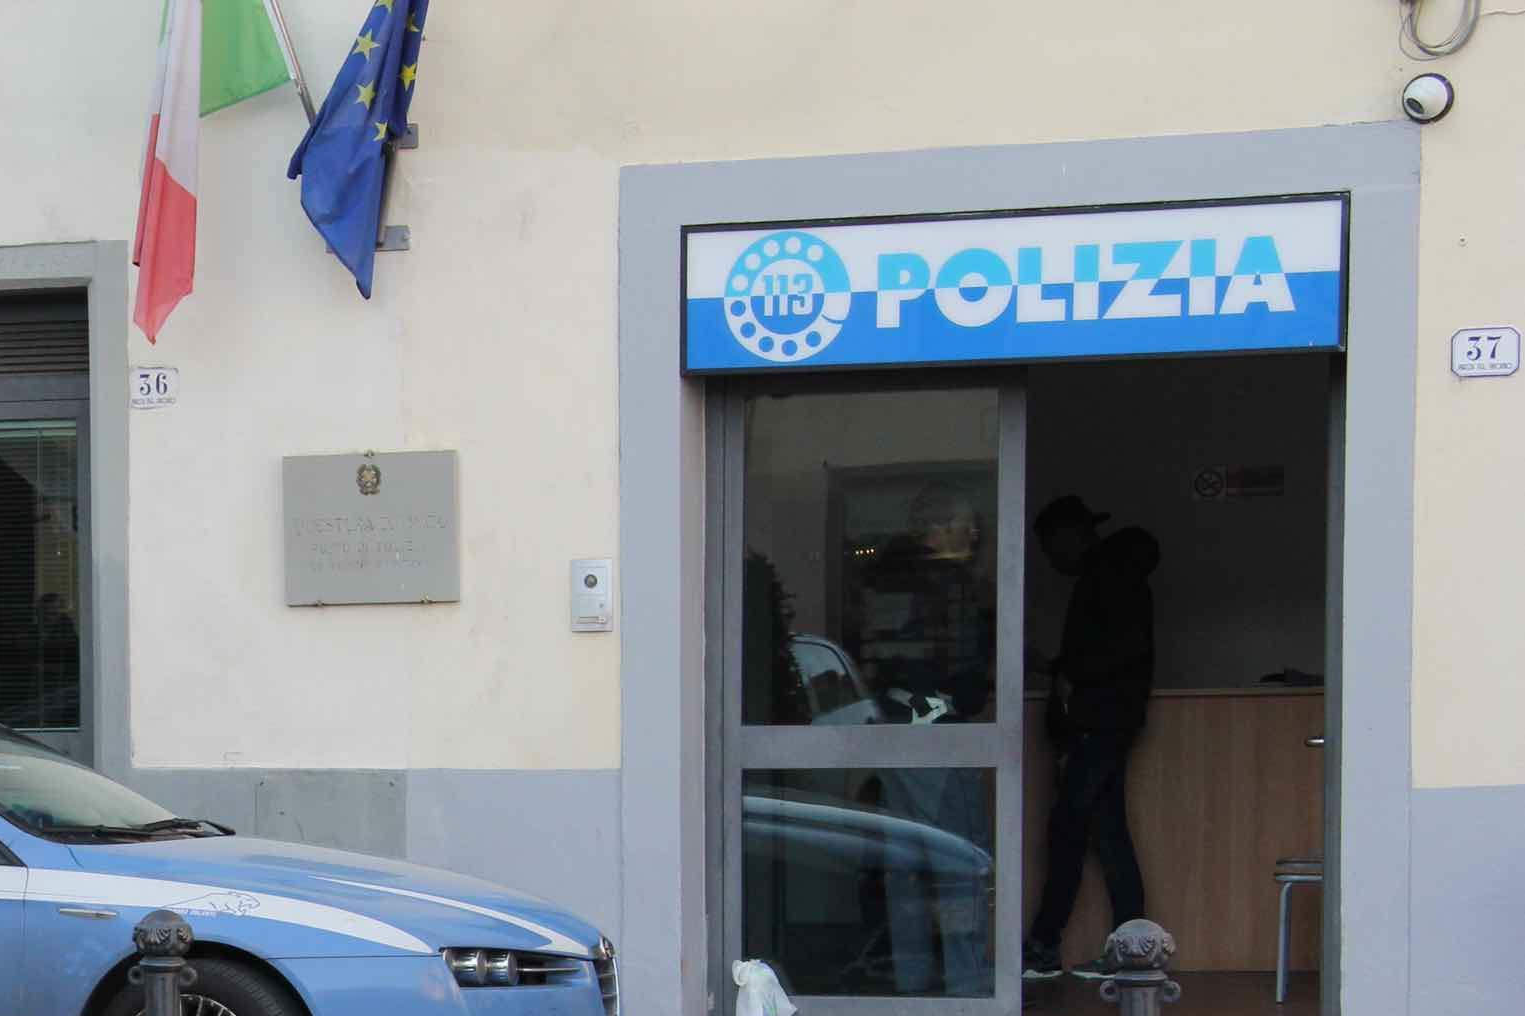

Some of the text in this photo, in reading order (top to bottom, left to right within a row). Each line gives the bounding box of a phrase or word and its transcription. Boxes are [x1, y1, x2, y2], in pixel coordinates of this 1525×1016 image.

[762, 274, 813, 316] 113
[876, 235, 1296, 329] POLIZIA
[1468, 336, 1502, 361] 37
[139, 372, 168, 396] 36
